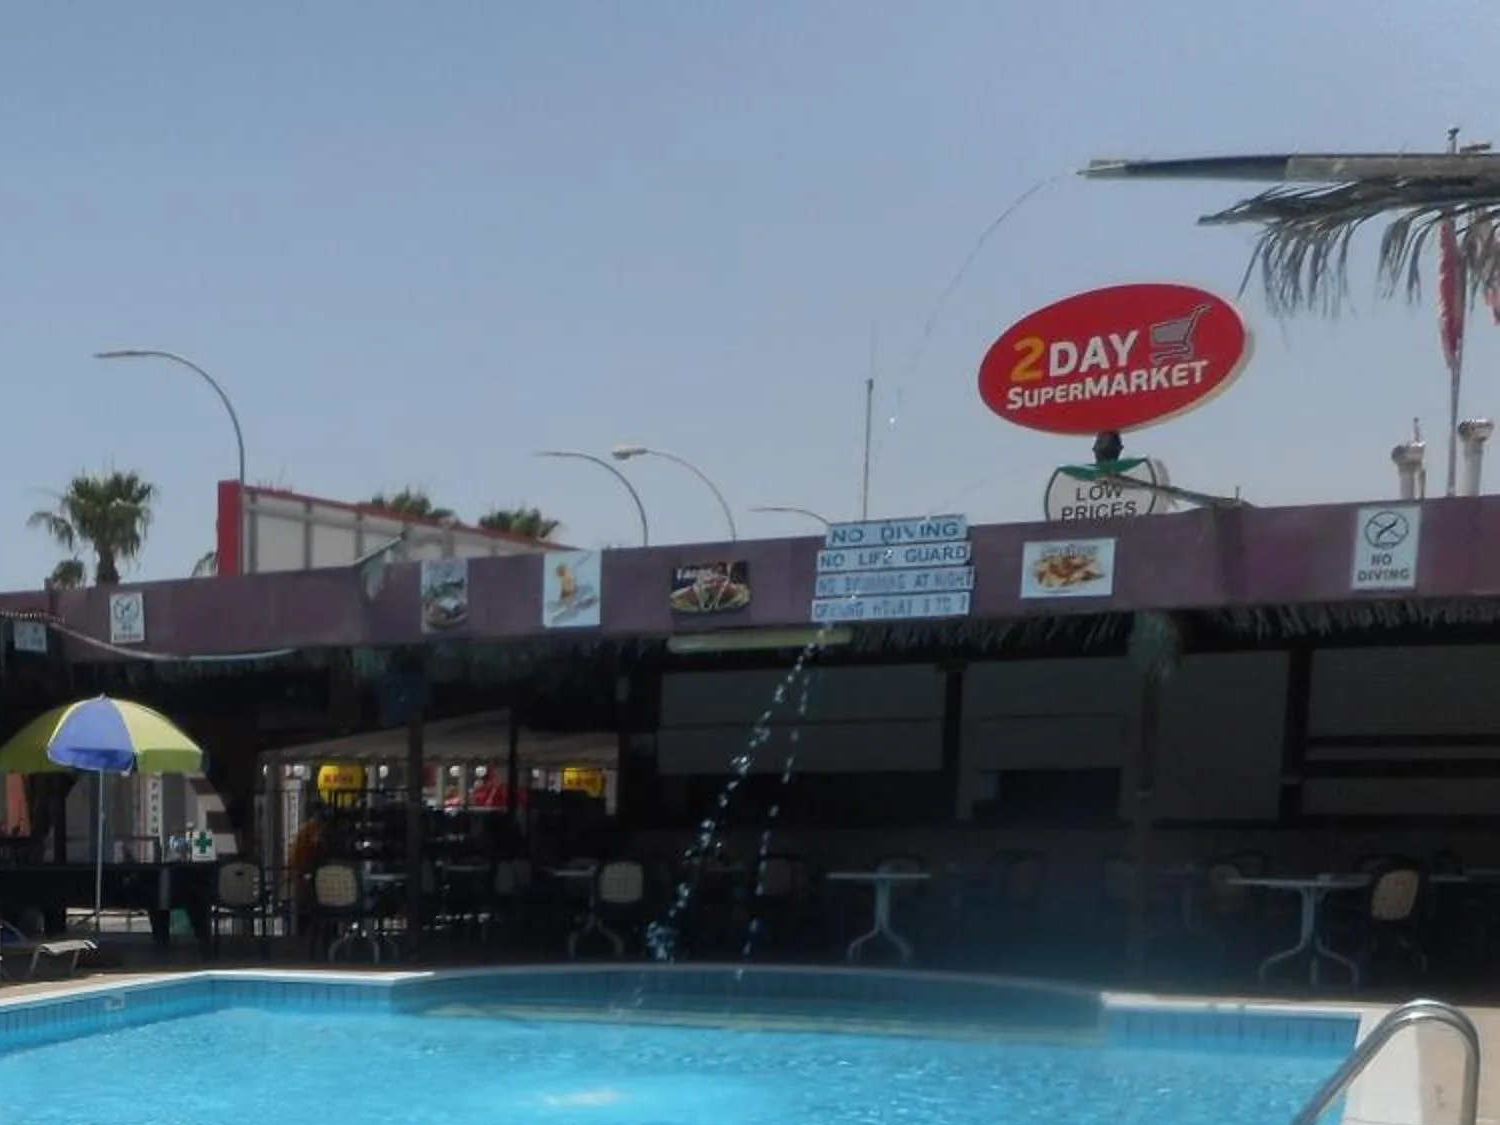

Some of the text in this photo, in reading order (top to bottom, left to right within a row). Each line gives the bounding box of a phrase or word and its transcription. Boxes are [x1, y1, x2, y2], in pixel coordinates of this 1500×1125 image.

[1010, 330, 1139, 383] 2DAY
[1076, 480, 1123, 501] LOW
[1062, 501, 1137, 522] PRICES
[831, 521, 959, 544] NO DIVING
[820, 553, 845, 570] NO
[905, 546, 967, 564] GUARD
[1371, 553, 1392, 566] NO
[913, 573, 930, 588] AT
[1357, 568, 1410, 582] DIVING
